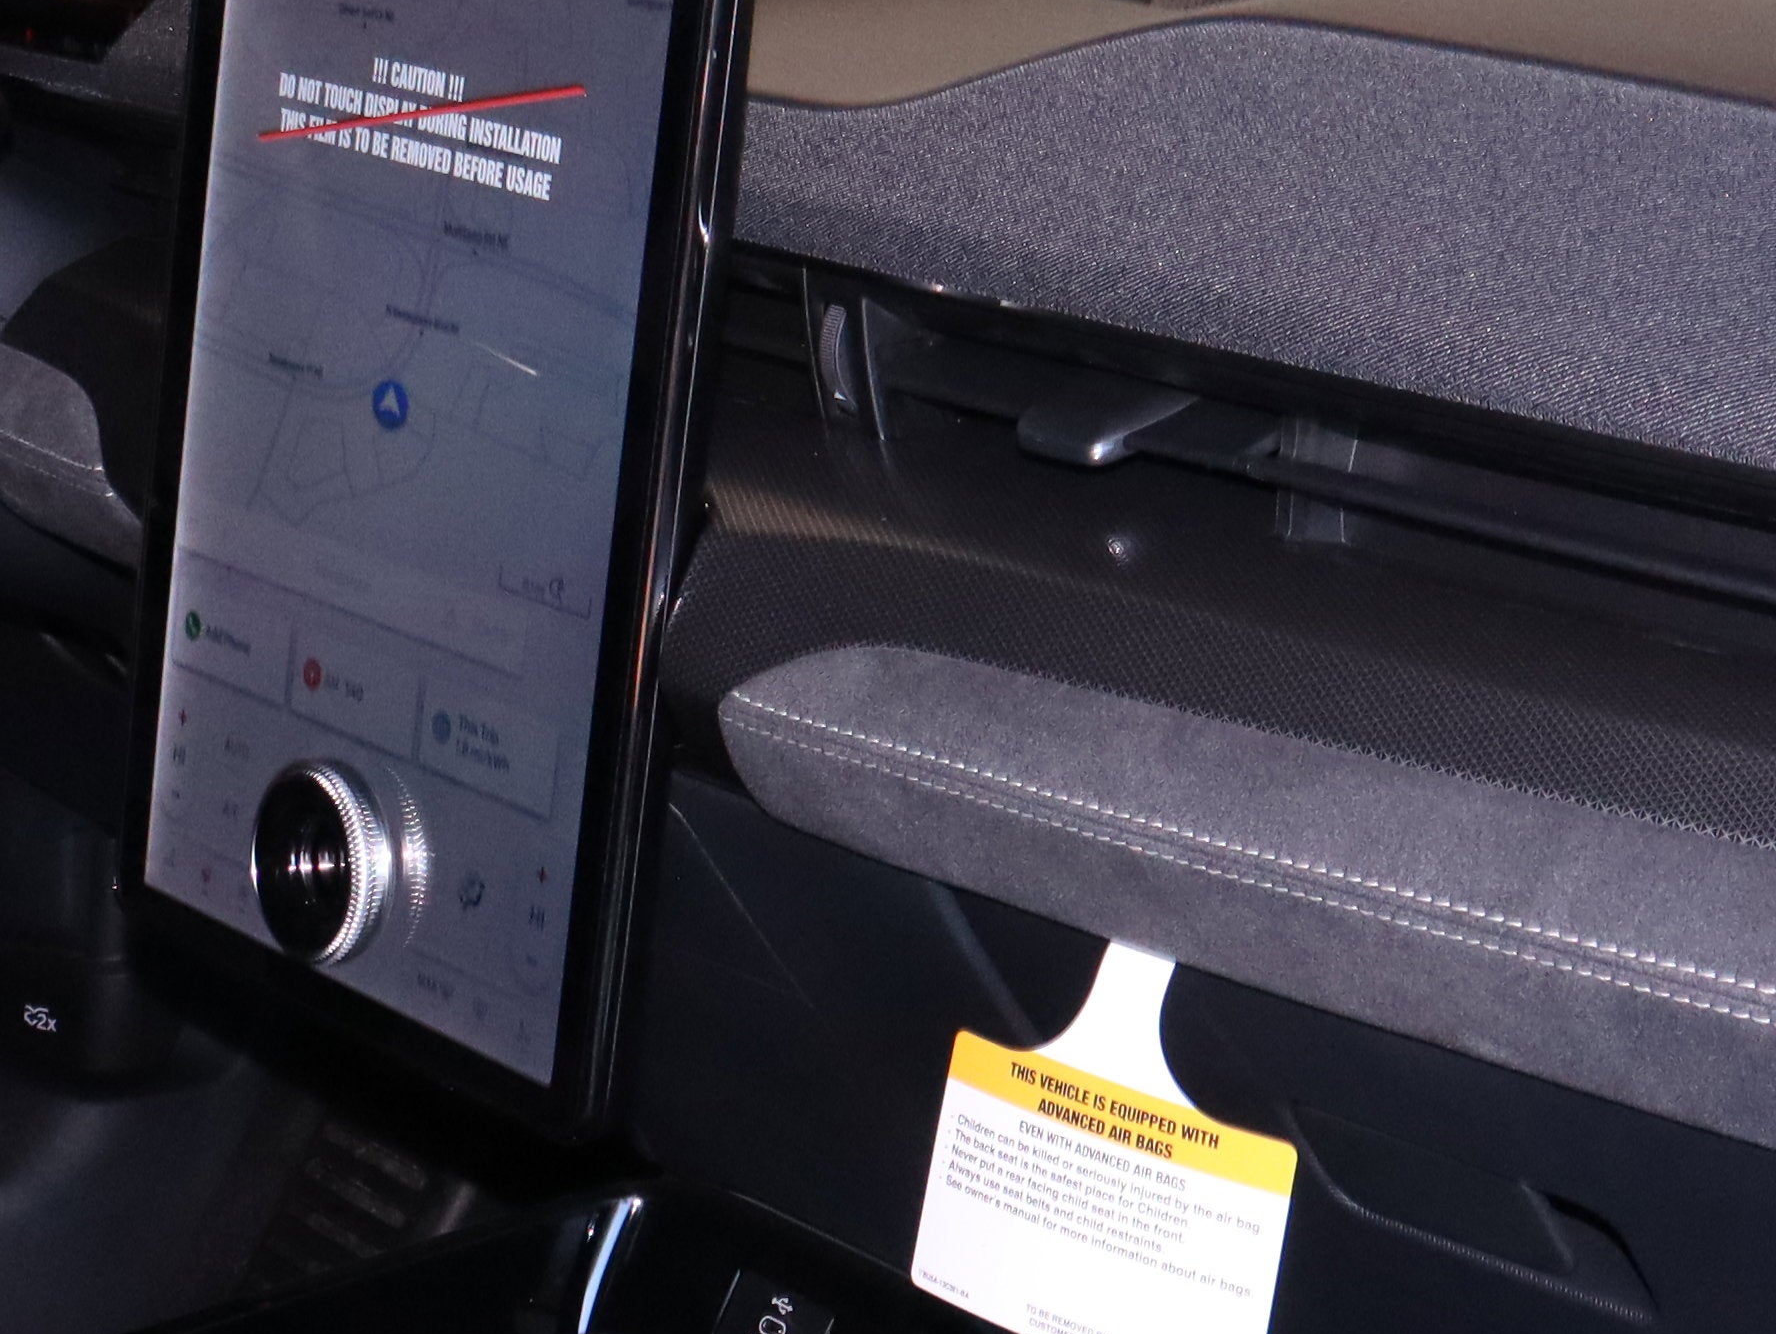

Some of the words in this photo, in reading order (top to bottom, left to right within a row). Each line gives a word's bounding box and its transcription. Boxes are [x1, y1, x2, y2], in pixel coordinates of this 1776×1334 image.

[279, 72, 296, 98] DO
[297, 75, 323, 105] NOT
[324, 82, 363, 116] TOUCH
[418, 104, 467, 141] DURING
[470, 116, 562, 165] INSTALLATION
[391, 62, 446, 98] CAUTION
[280, 107, 307, 133] THIS
[338, 126, 351, 149] IS
[355, 128, 371, 155] TO
[372, 132, 389, 159] BE
[390, 136, 451, 175] REMOVED
[453, 152, 504, 189] BEFORE
[505, 164, 553, 202] USAGE
[1010, 1061, 1036, 1085] THIS
[1040, 1073, 1090, 1105] VEHICLE
[1093, 1094, 1106, 1111] IS
[1109, 1100, 1177, 1135] EQUIPPED
[1181, 1123, 1219, 1149] WITH
[1037, 1098, 1105, 1135] ADVANCED
[1109, 1124, 1132, 1145] AIR
[1136, 1134, 1173, 1159] BAGS
[948, 1159, 981, 1184] Always
[983, 1176, 1001, 1191] use
[1003, 1184, 1024, 1201] seat
[1026, 1193, 1051, 1212] belts
[1053, 1206, 1074, 1222] and
[1076, 1215, 1104, 1233] child
[952, 1144, 977, 1163] Never
[979, 1158, 995, 1173] put
[1006, 1170, 1025, 1184] rear
[1028, 1177, 1059, 1201] facing
[1062, 1191, 1088, 1210] child
[1091, 1203, 1116, 1219] seat
[1118, 1212, 1129, 1224] in
[1132, 1217, 1151, 1232] the
[955, 1128, 971, 1144] The
[974, 1135, 995, 1155] back
[998, 1149, 1019, 1164] seat
[1020, 1157, 1029, 1170] is
[1032, 1161, 1048, 1176] the
[1050, 1170, 1083, 1191] safest
[1085, 1184, 1115, 1203] place
[1118, 1195, 1134, 1209] for
[957, 1114, 995, 1139] Children
[998, 1133, 1015, 1147] can
[1018, 1140, 1030, 1153] be
[1032, 1146, 1060, 1165] killed
[1062, 1159, 1073, 1170] or
[1076, 1166, 1127, 1192] seriously
[1130, 1182, 1172, 1206] injured
[1175, 1197, 1190, 1214] by
[1193, 1203, 1213, 1218] the
[1216, 1212, 1232, 1225] air
[1019, 1120, 1043, 1140] EVEN
[1047, 1131, 1072, 1152] WITH
[1075, 1143, 1130, 1173] ADVANCED
[1133, 1164, 1152, 1179] AIR
[1156, 1171, 1186, 1192] BAGS
[946, 1174, 962, 1191] See
[964, 1185, 1001, 1208] owner's
[1003, 1202, 1042, 1225] manual
[1043, 1215, 1058, 1231] for
[1060, 1225, 1088, 1244] more
[1091, 1235, 1158, 1268] information
[1161, 1261, 1196, 1280] about
[1200, 1274, 1217, 1287] air
[1026, 1303, 1037, 1315] TO
[1039, 1309, 1050, 1321] BE
